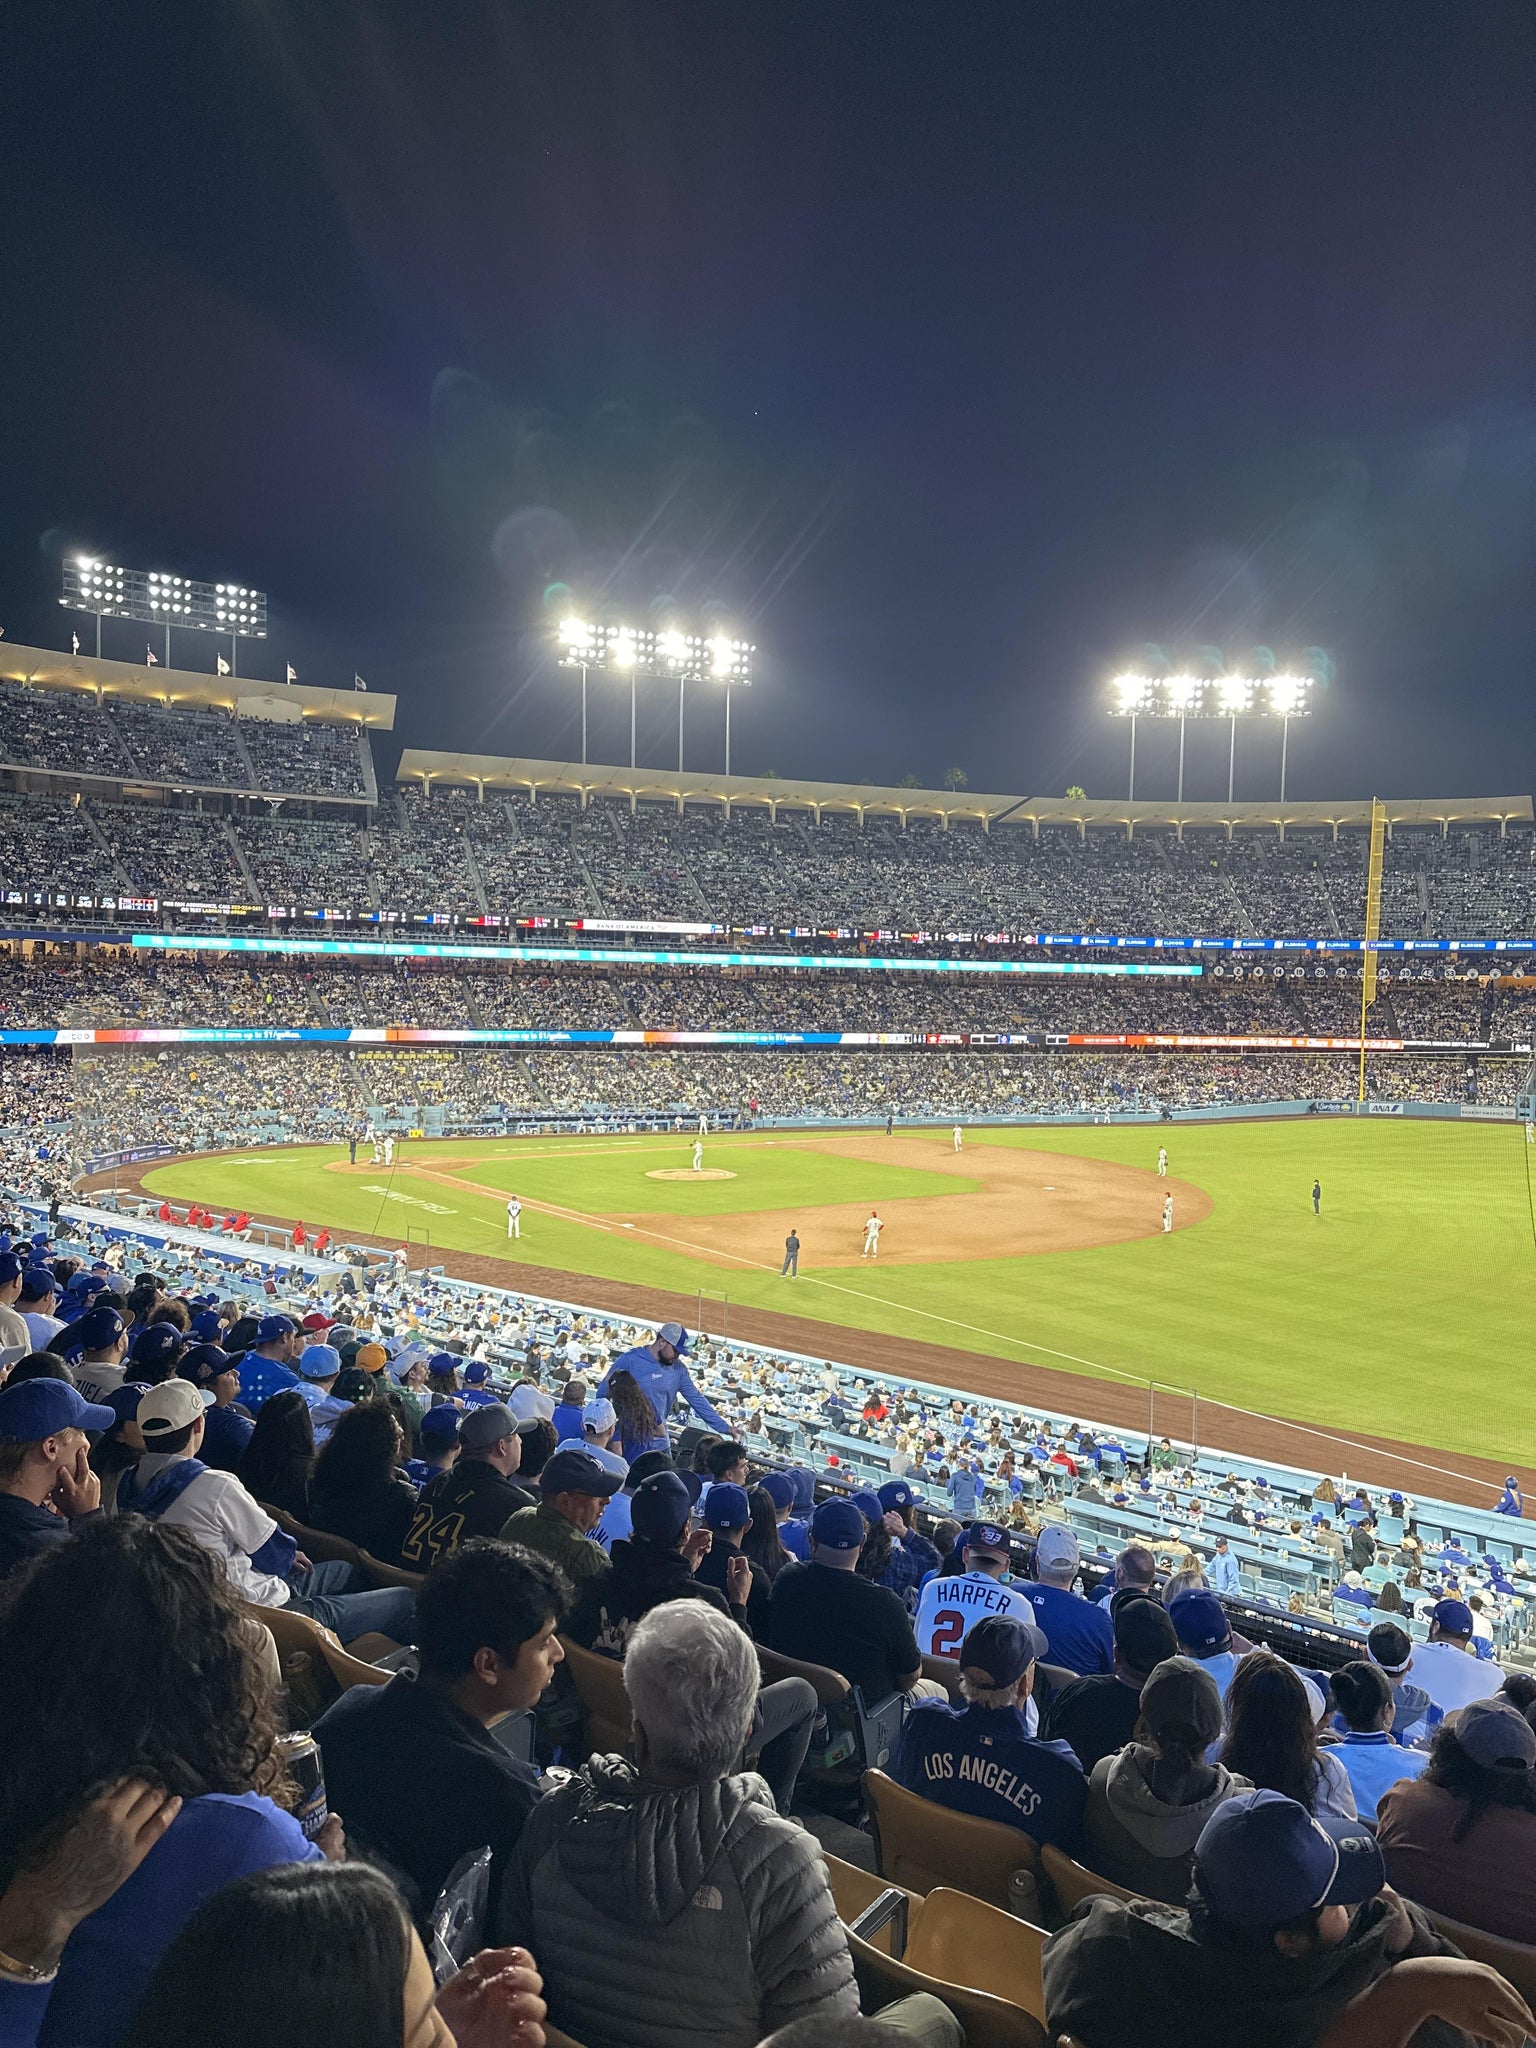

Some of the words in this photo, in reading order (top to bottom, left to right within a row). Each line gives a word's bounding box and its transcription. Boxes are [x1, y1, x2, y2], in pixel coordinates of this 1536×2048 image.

[401, 1502, 466, 1568] 24
[938, 1583, 1012, 1614] HARPER
[924, 1752, 954, 1780] LOS
[958, 1754, 1042, 1816] ANGELES
